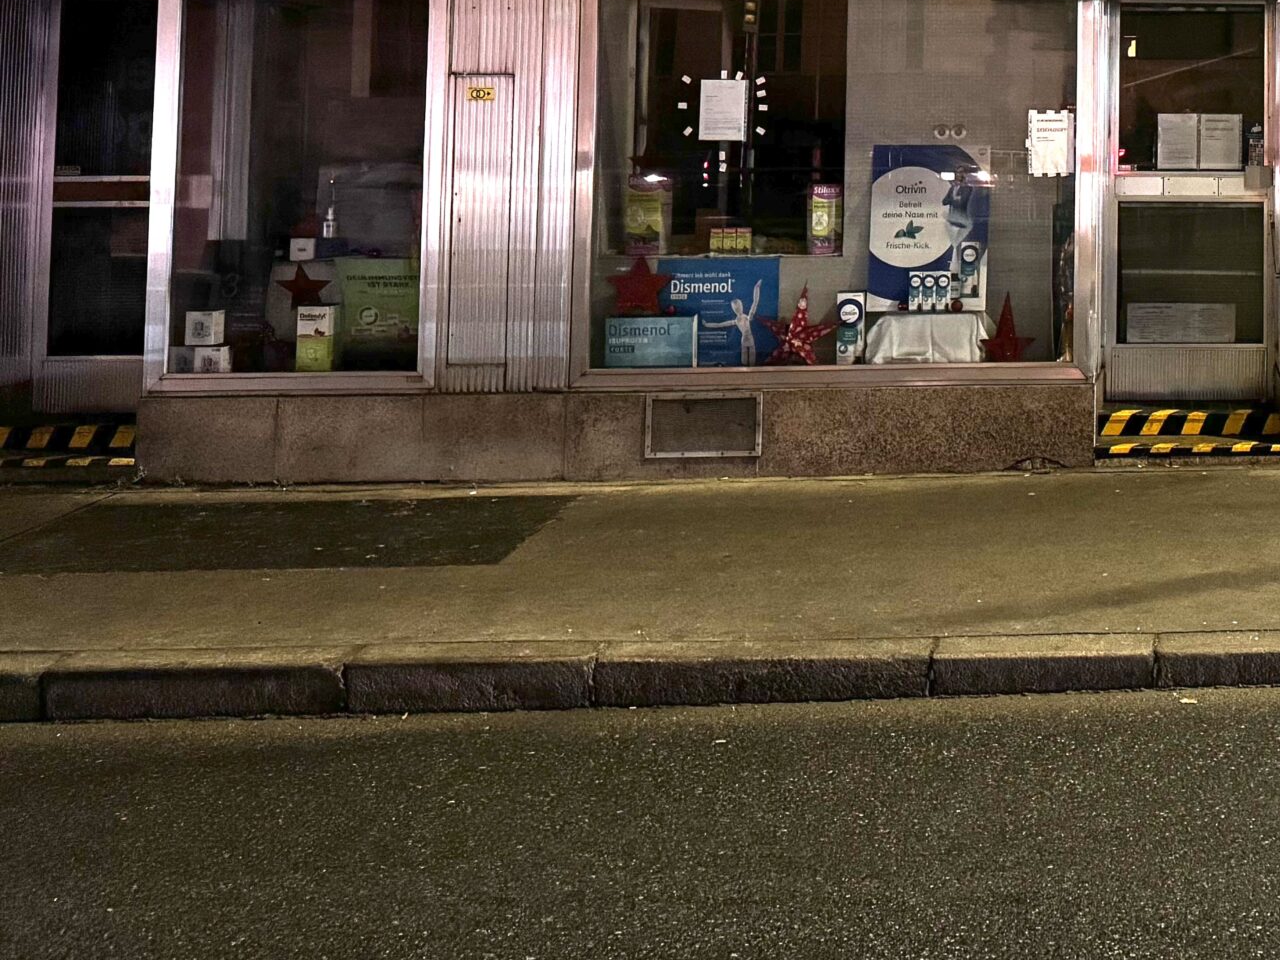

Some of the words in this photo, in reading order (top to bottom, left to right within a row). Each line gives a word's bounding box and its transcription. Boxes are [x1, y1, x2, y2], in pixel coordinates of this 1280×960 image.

[895, 181, 927, 194] Otrivin
[899, 201, 922, 209] Befreit
[882, 211, 903, 219] deine
[905, 210, 924, 219] Nase
[926, 211, 938, 219] mit
[671, 279, 733, 294] Dismenol
[608, 324, 671, 336] Dismenol
